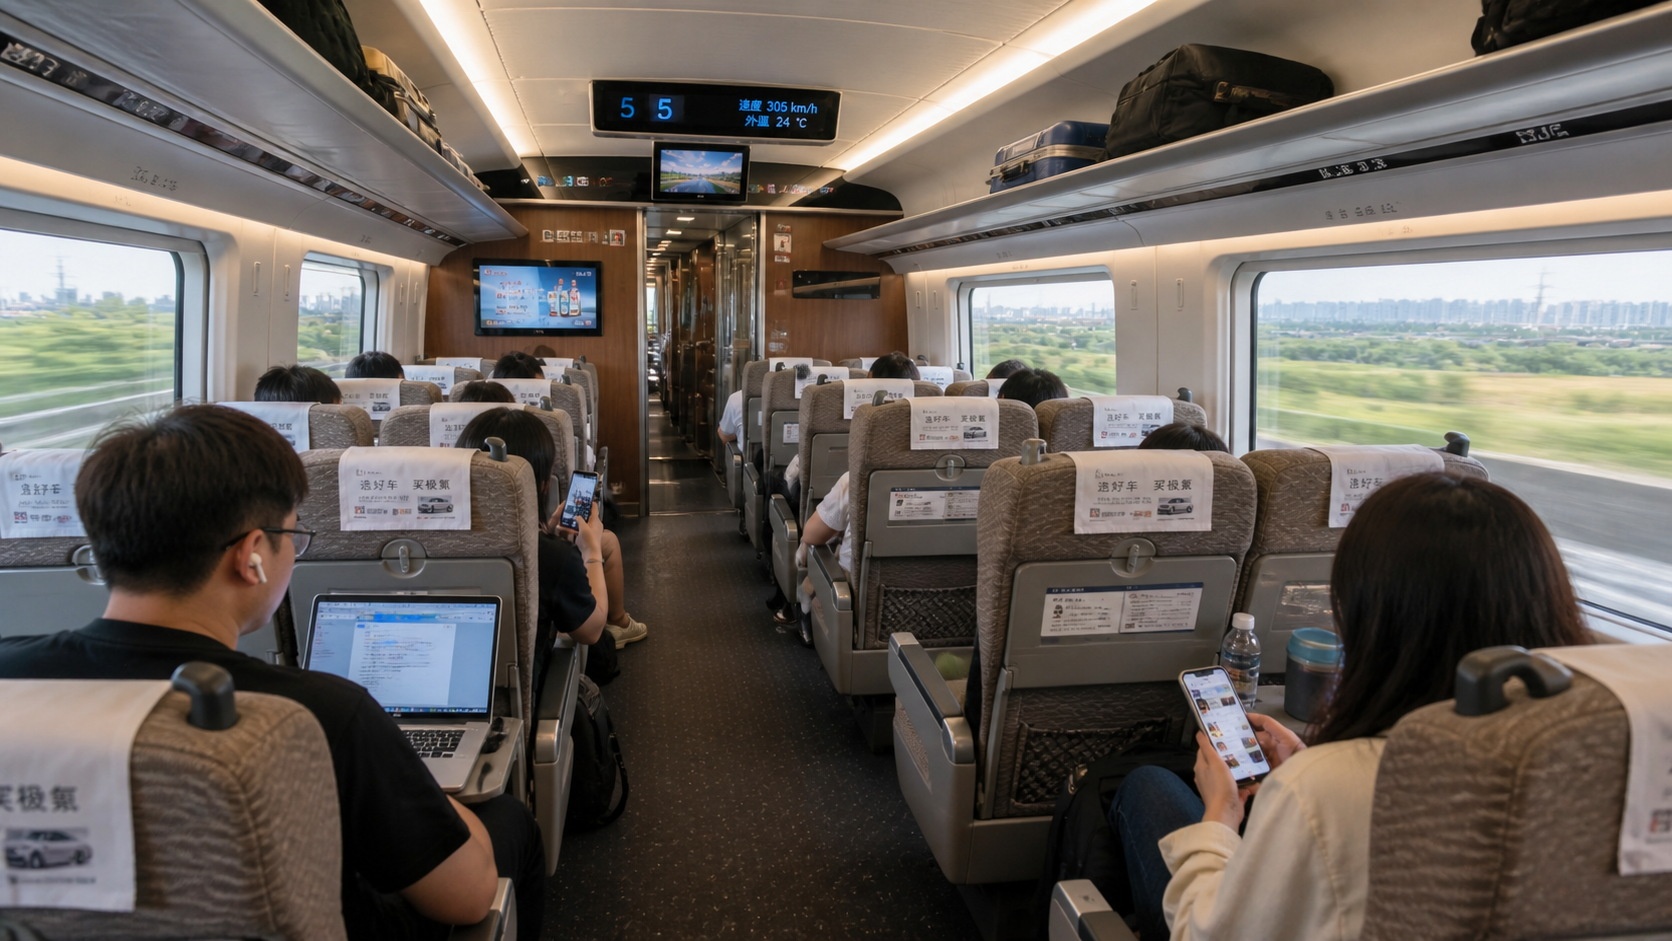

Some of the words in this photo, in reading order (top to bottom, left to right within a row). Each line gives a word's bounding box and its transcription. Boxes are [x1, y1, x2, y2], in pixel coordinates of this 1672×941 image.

[620, 97, 635, 119] 5
[657, 98, 673, 120] 5
[766, 101, 788, 113] 305
[790, 102, 818, 114] km/h
[775, 116, 790, 128] 24
